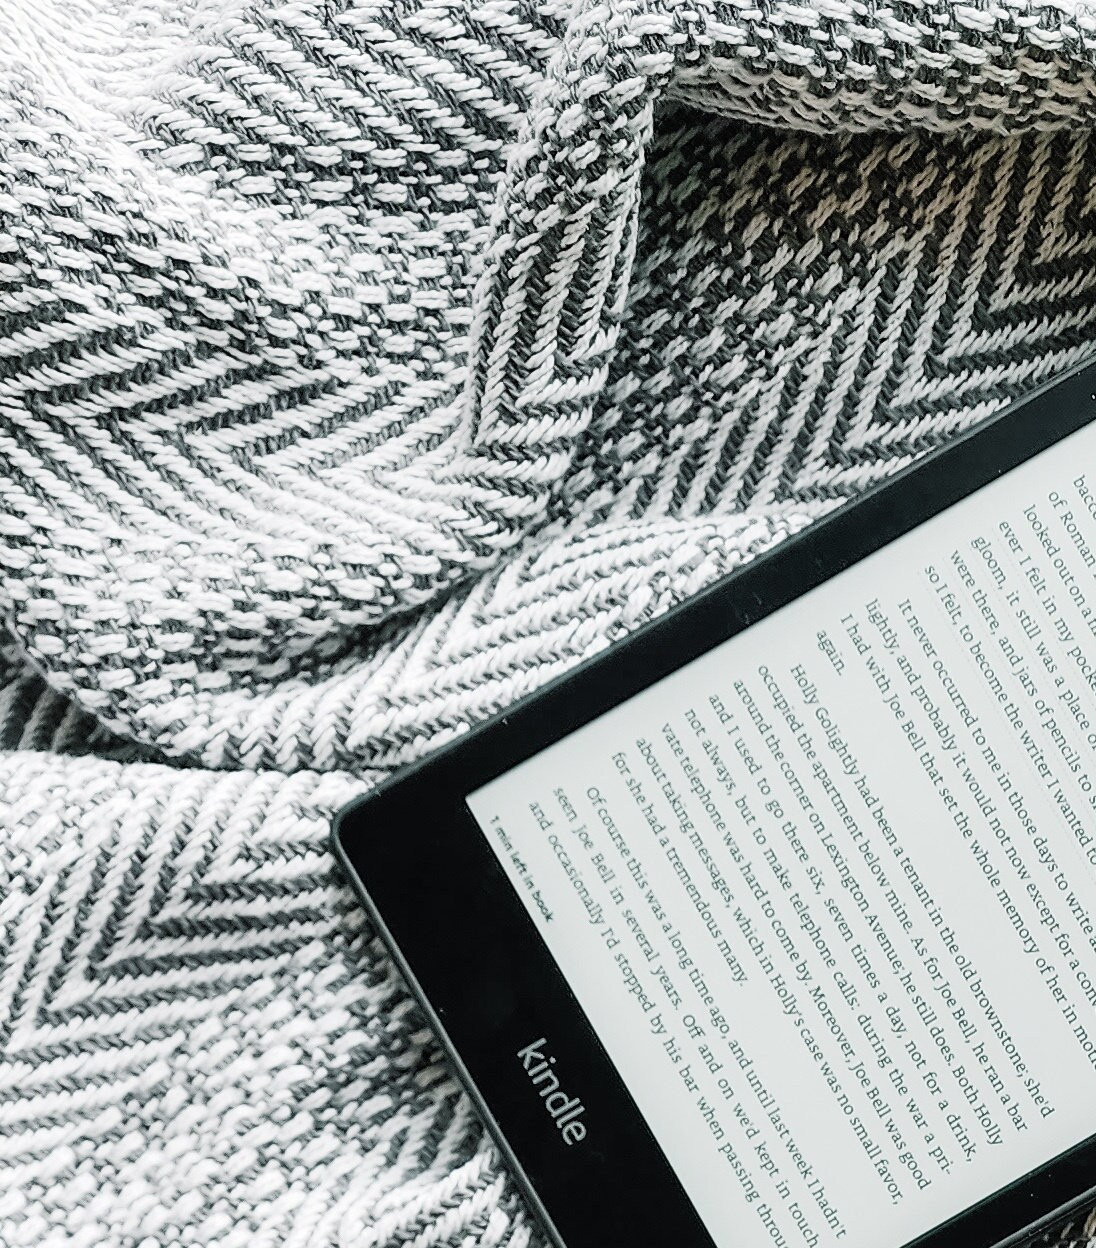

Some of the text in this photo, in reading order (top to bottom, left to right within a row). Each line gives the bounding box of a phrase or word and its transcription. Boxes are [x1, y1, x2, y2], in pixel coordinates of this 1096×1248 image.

[1023, 504, 1061, 559] looked
[1053, 558, 1075, 587] out
[1069, 585, 1086, 608] on
[1048, 491, 1068, 510] of
[1059, 510, 1096, 568] Roman
[865, 598, 900, 655] lightly,
[896, 654, 922, 687] and
[910, 684, 958, 751] probably
[952, 751, 966, 769] it
[961, 766, 998, 818] would
[988, 816, 1012, 847] not
[1004, 845, 1032, 880] now
[1026, 883, 1060, 934] except
[1054, 932, 1075, 958] for
[924, 565, 940, 584] so
[940, 593, 962, 626] felt,
[959, 624, 974, 643] to
[969, 640, 1008, 704] become
[1003, 702, 1024, 731] the
[1020, 729, 1053, 779] writer
[1053, 788, 1094, 849] wanted
[510, 851, 527, 876] left
[611, 752, 631, 775] for
[625, 778, 646, 806] she
[641, 803, 667, 836] had
[666, 847, 723, 939] tremendous
[733, 680, 1003, 1145] around the corner on Lexington Avenue; he still does. Both Holly
[790, 663, 820, 705] Holly
[815, 707, 860, 776] Golightly
[853, 774, 880, 809] had
[871, 805, 898, 847] been
[900, 857, 935, 910] tenant
[927, 906, 944, 928] in
[939, 926, 960, 955] the
[954, 954, 978, 982] old
[969, 977, 1029, 1078] brownstone;
[516, 1037, 587, 1146] kindle
[553, 788, 578, 823] seen
[571, 824, 594, 850] Joe
[590, 852, 616, 884] Bell
[609, 885, 625, 906] in
[621, 909, 660, 963] several
[682, 1014, 707, 1040] Off
[698, 1043, 724, 1075] and
[717, 1078, 735, 1100] on
[753, 1140, 780, 1179] kept
[775, 1179, 791, 1200] in
